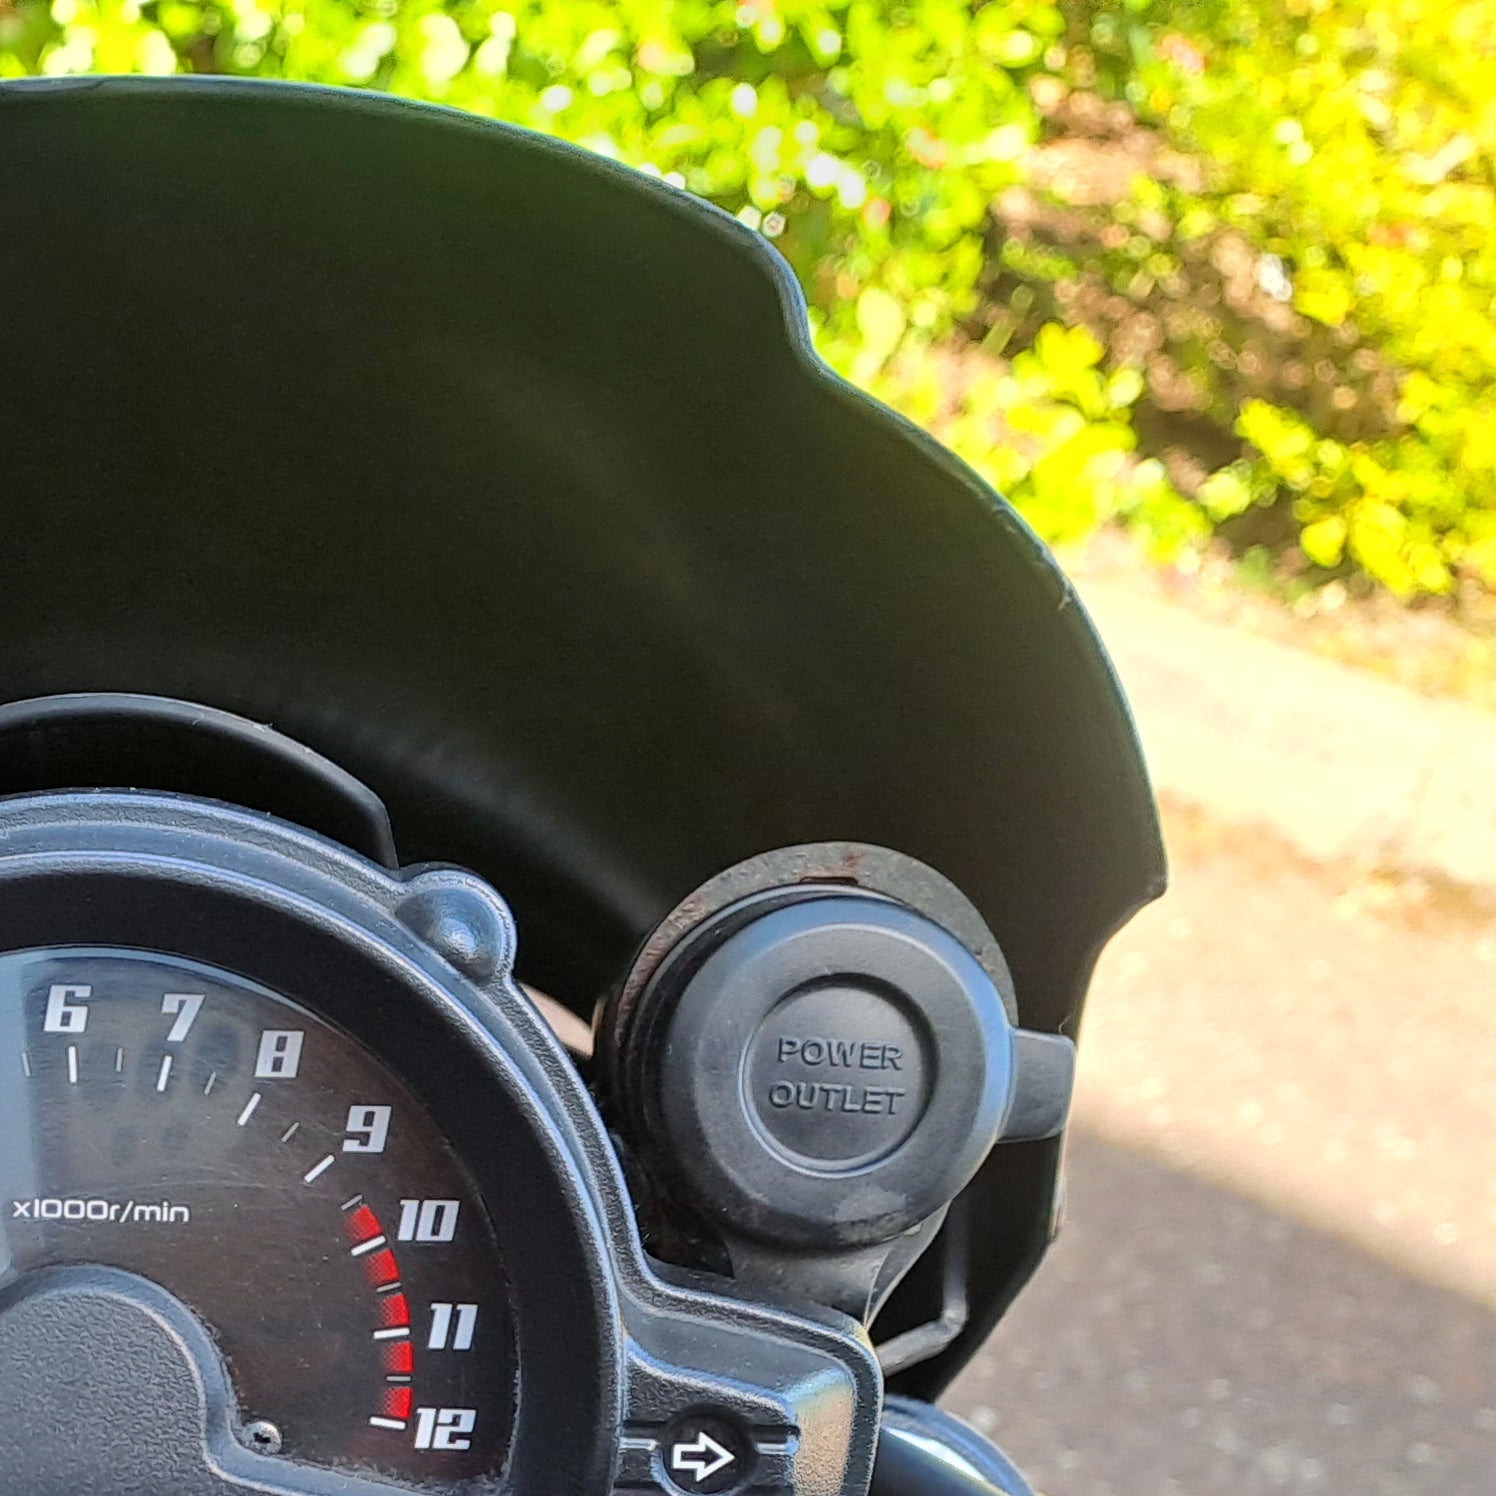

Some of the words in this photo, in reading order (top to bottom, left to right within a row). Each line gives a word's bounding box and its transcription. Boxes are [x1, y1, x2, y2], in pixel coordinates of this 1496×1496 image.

[44, 984, 92, 1033] 6
[161, 993, 205, 1041] 7
[254, 1030, 304, 1078] 8
[777, 1036, 904, 1072] POWER
[768, 1080, 905, 1116] OUTLET
[342, 1105, 392, 1153] 9
[12, 1199, 190, 1222] x1000r/min
[398, 1200, 460, 1242] 10
[428, 1303, 478, 1350] 11
[414, 1408, 476, 1450] 12
